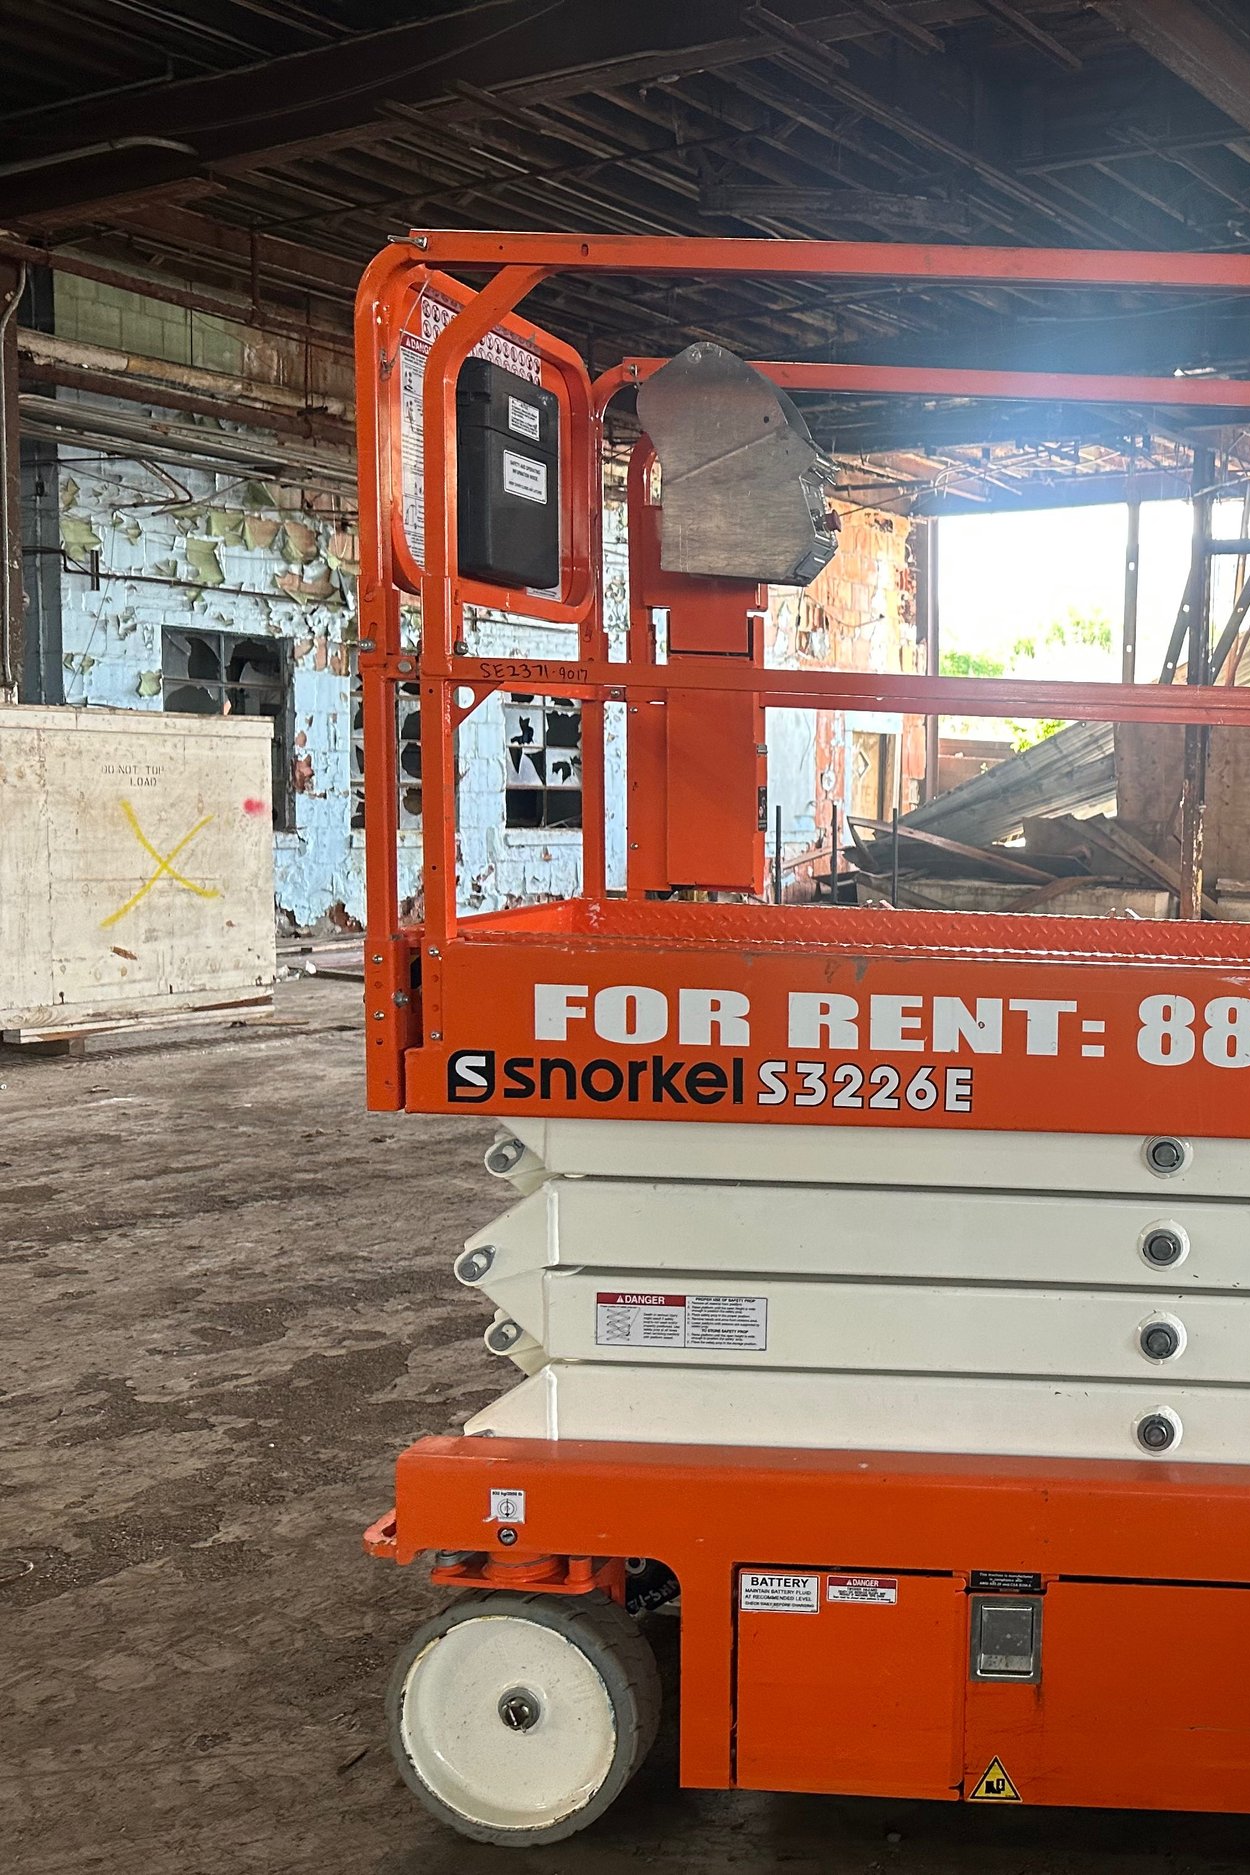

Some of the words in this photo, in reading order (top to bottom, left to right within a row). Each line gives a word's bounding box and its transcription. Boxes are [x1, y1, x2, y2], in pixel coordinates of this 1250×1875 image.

[118, 765, 137, 775] NOT
[130, 777, 157, 787] LOAD
[533, 983, 750, 1048] FOR
[787, 990, 1105, 1058] RENT:
[503, 1055, 744, 1105] snorkel
[757, 1060, 973, 1112] S3226E
[624, 1295, 665, 1304] DANGER
[751, 1577, 809, 1588] BATTERY
[852, 1579, 880, 1587] DANGER
